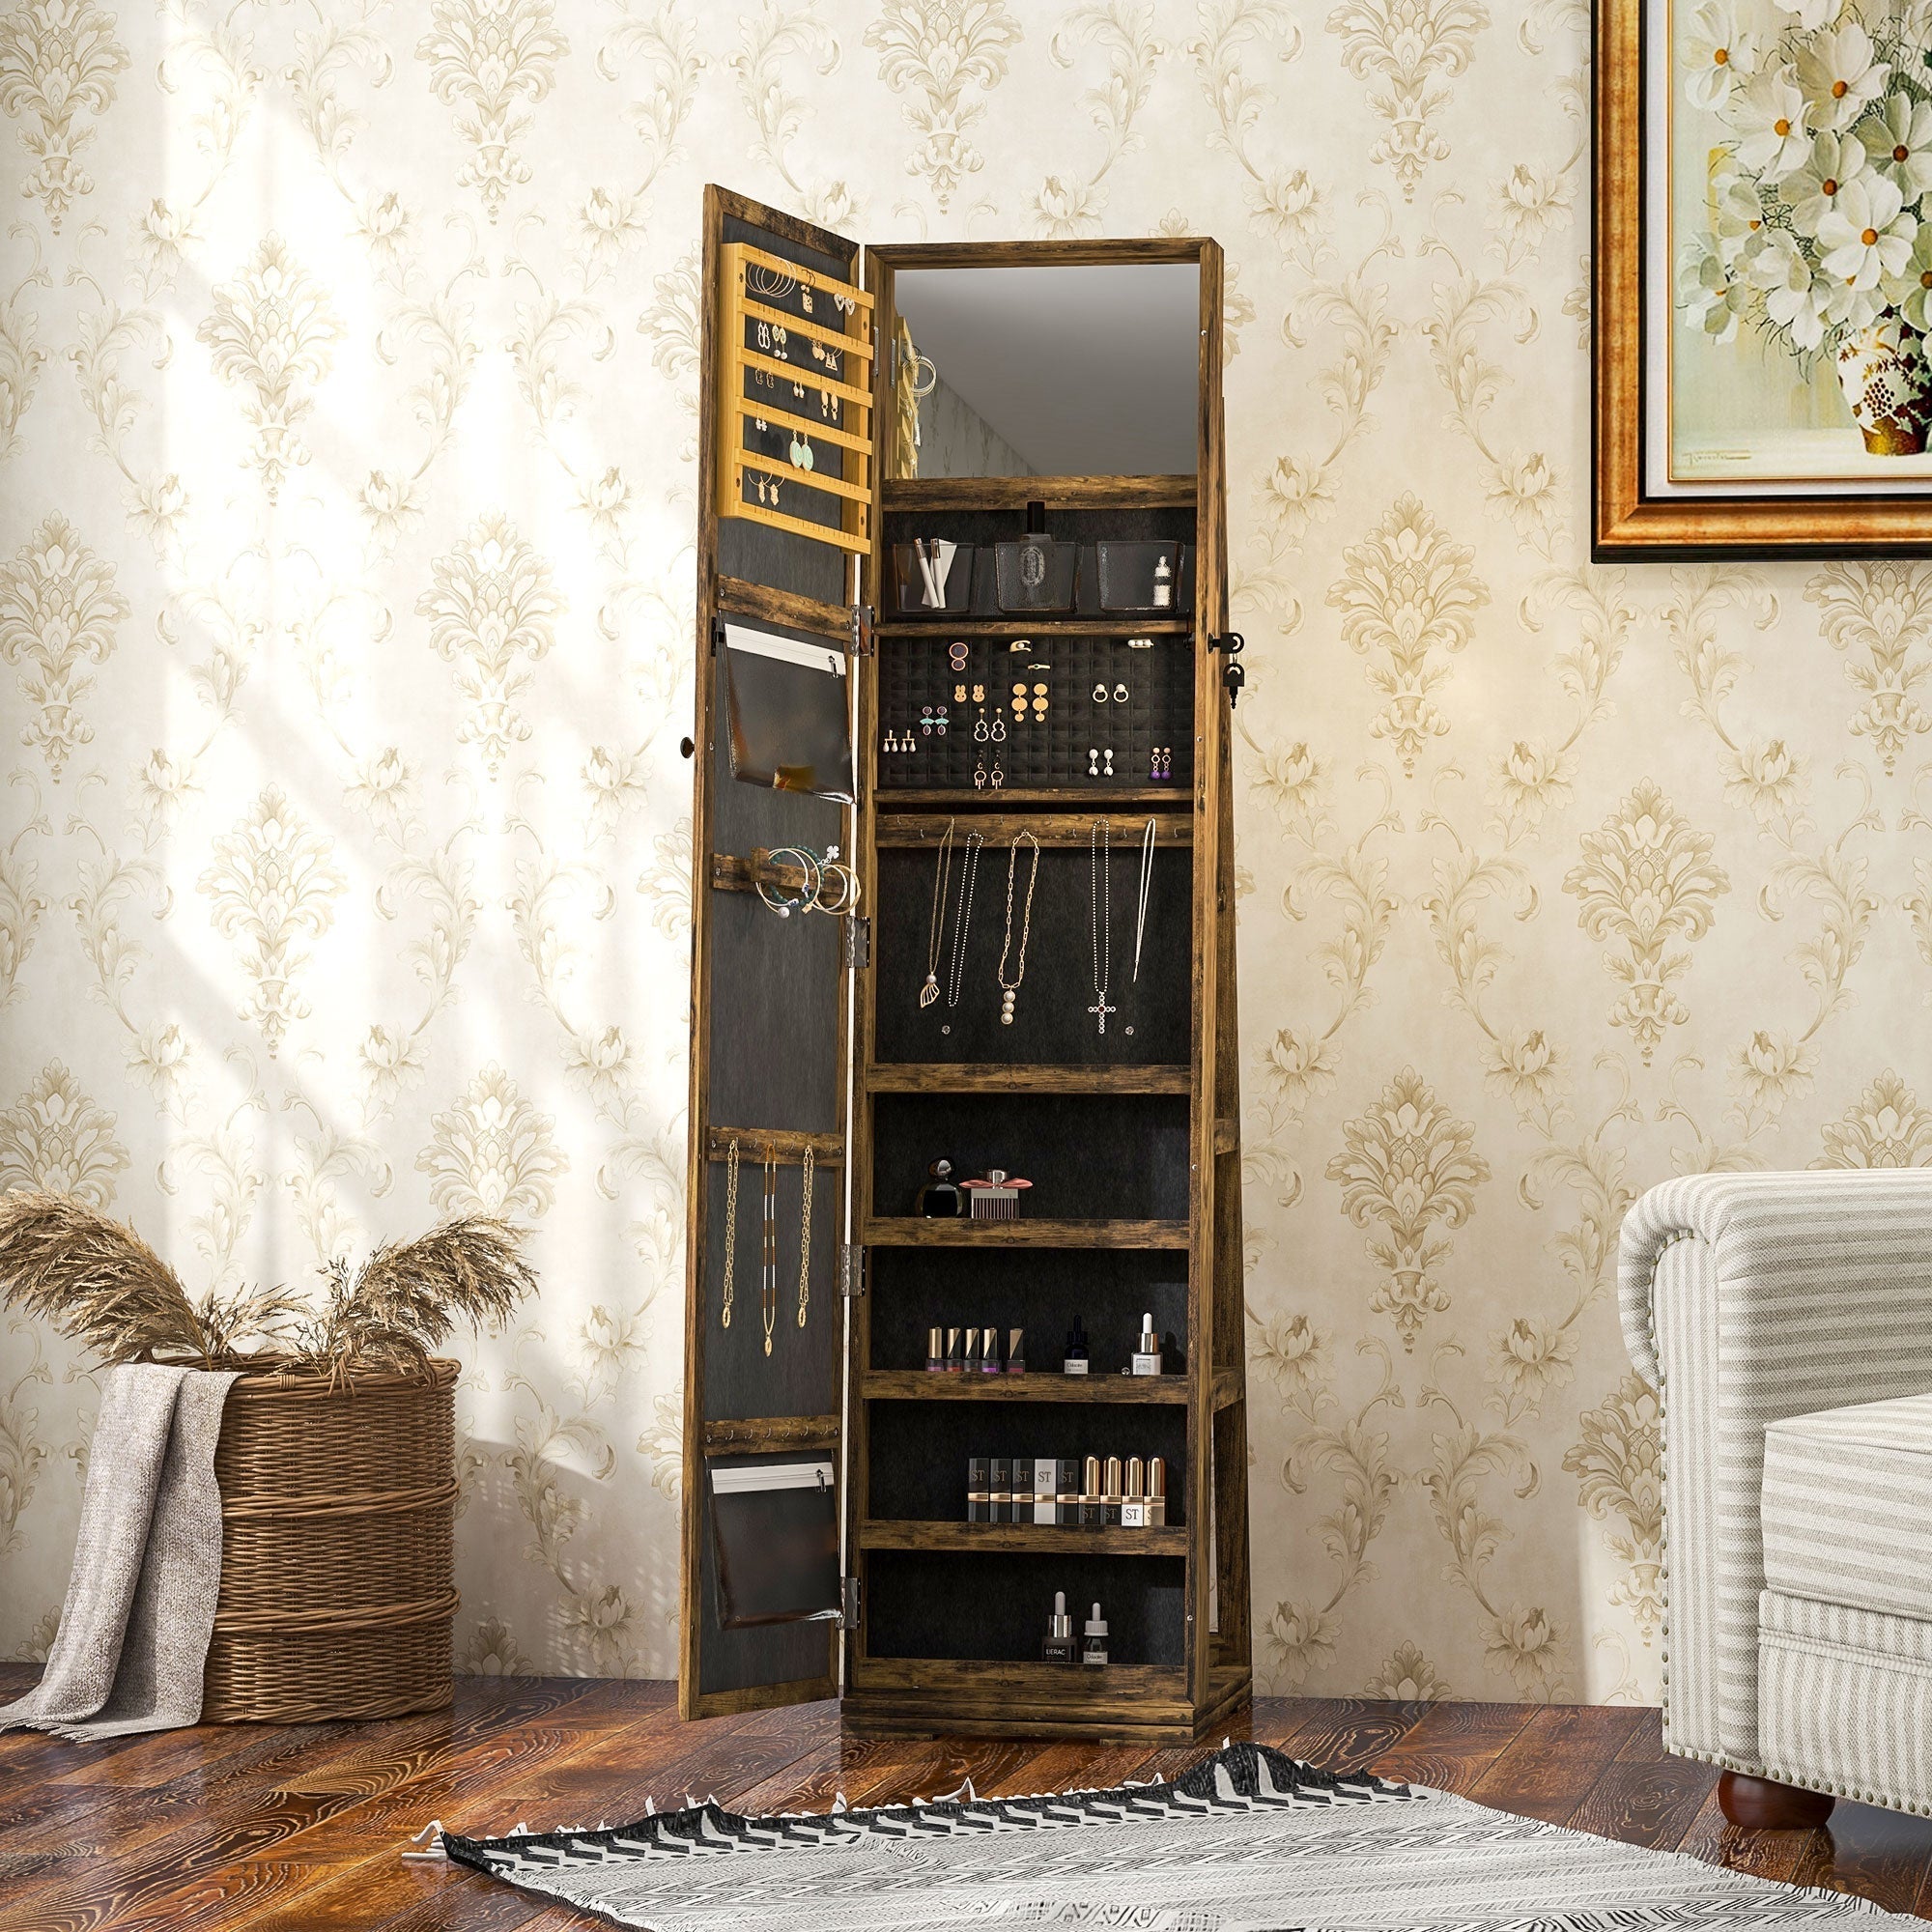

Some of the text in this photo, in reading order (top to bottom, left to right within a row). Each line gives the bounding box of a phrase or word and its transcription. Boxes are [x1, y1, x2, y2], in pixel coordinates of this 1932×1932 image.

[971, 1469, 985, 1482] ST
[993, 1469, 1008, 1482] ST
[1015, 1470, 1030, 1482] ST
[1037, 1471, 1052, 1483] ST
[1083, 1508, 1095, 1520] ST
[1104, 1508, 1118, 1520] ST
[1125, 1508, 1140, 1520] ST
